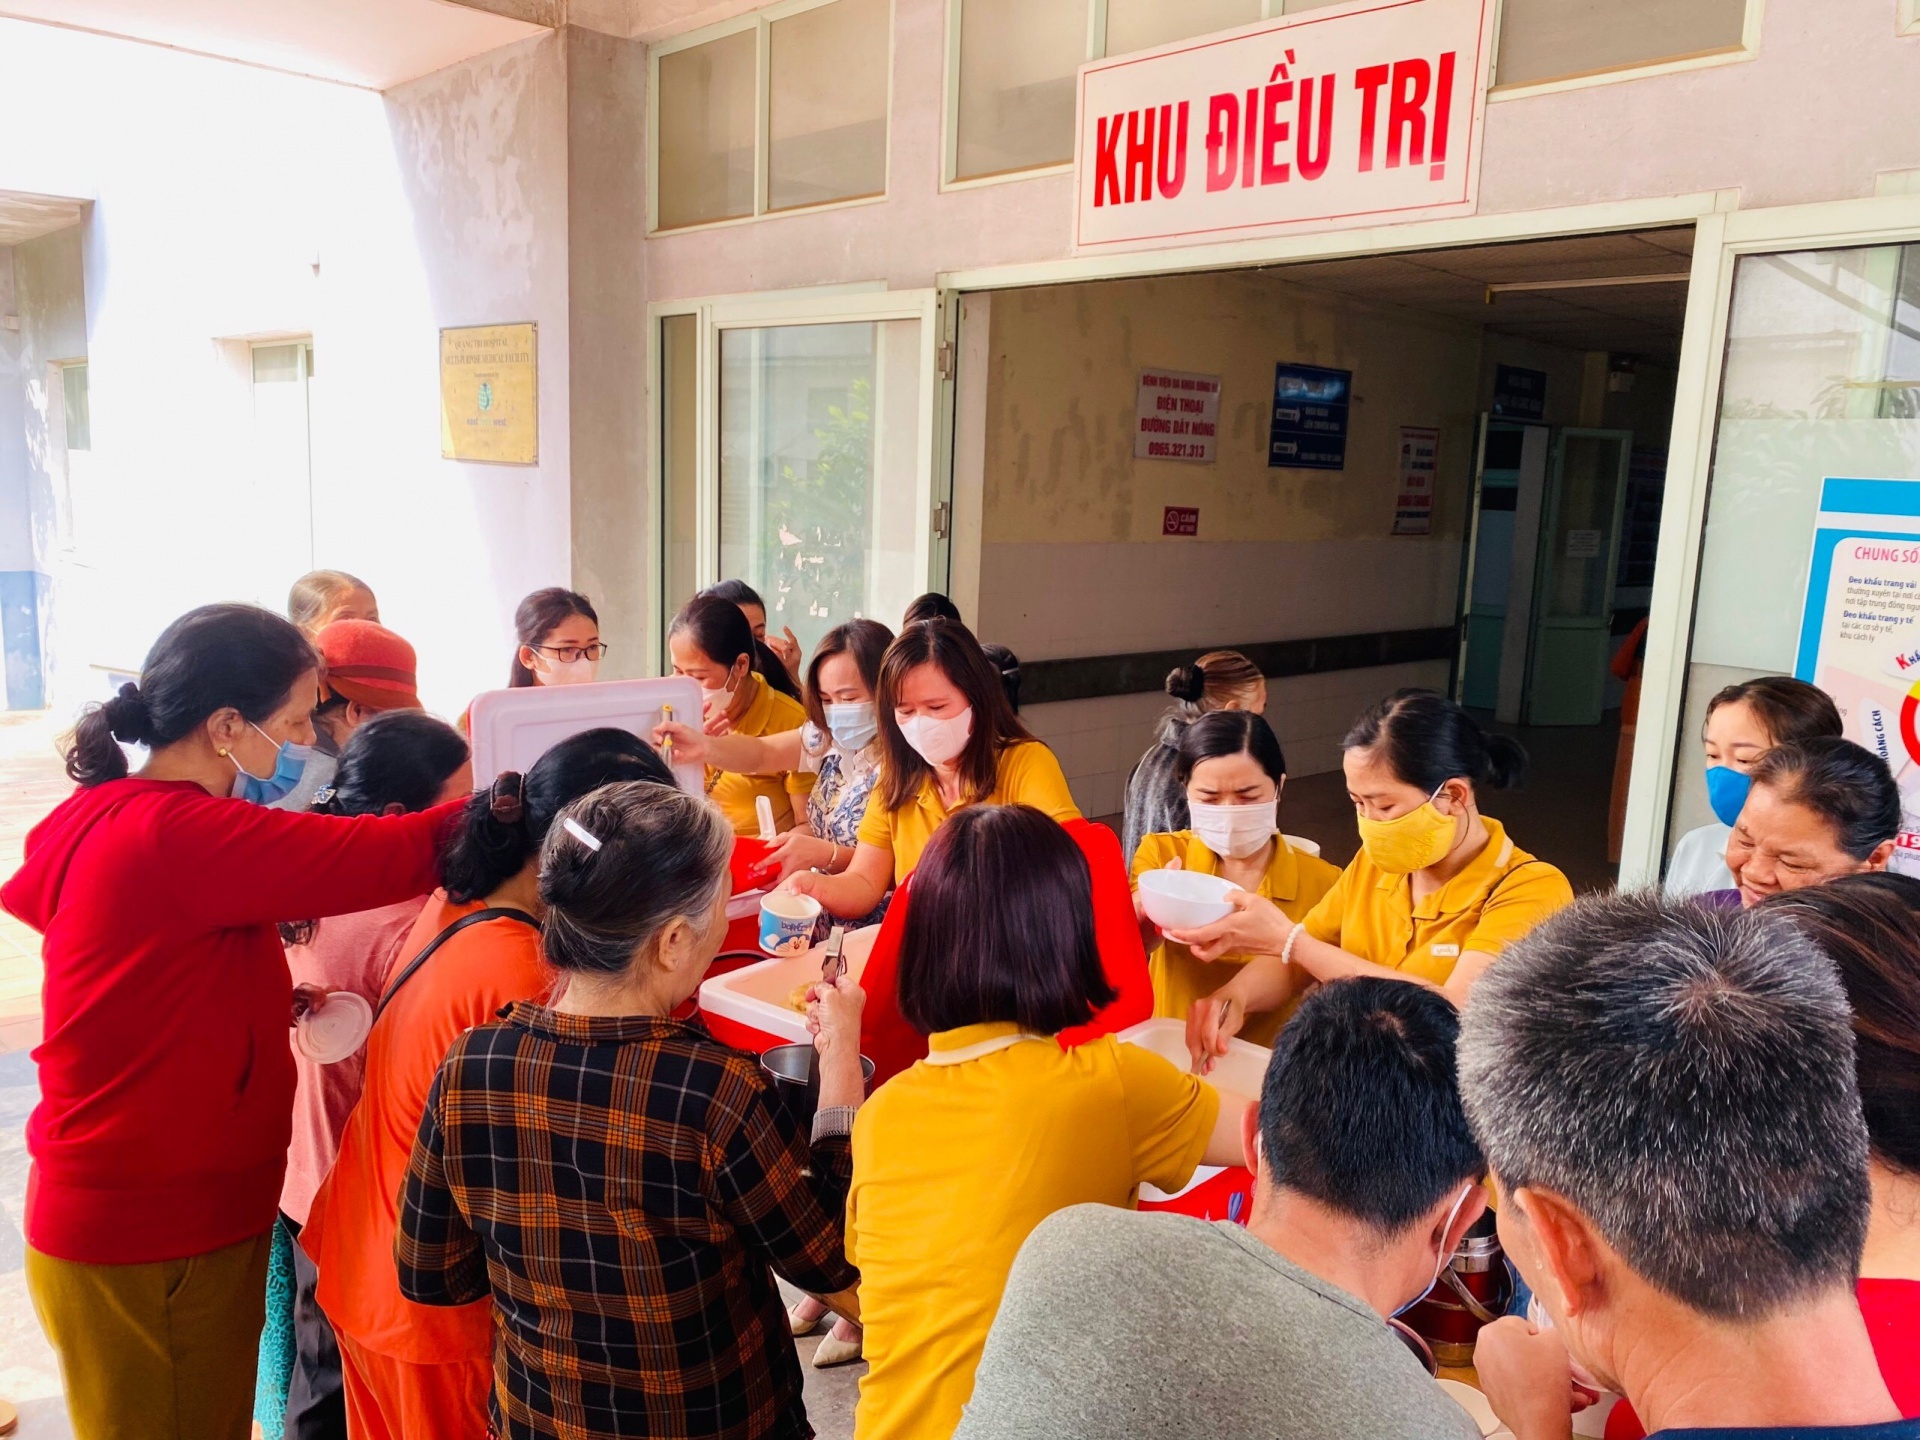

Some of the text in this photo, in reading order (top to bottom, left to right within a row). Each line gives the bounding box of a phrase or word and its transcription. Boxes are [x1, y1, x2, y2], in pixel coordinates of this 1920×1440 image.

[1094, 48, 1456, 208] KHU ĐIỀU TRỊ
[506, 352, 529, 363] FACILITY
[1157, 394, 1204, 416] ĐIỆN THOẠI
[1141, 414, 1215, 436] ĐƯỜNG DÂY NÓNG
[1148, 441, 1205, 458] 0965.321.313
[1855, 546, 1920, 563] CHUNG SỐ
[1848, 575, 1862, 584] Đeo
[1884, 580, 1904, 589] trang
[1871, 589, 1891, 598] xuyên
[1869, 599, 1887, 609] trung
[1843, 610, 1857, 618] Đeo
[1878, 614, 1898, 624] trang
[1840, 631, 1852, 639] khu
[1872, 709, 1884, 732] CÁCH
[1436, 947, 1454, 955] yody
